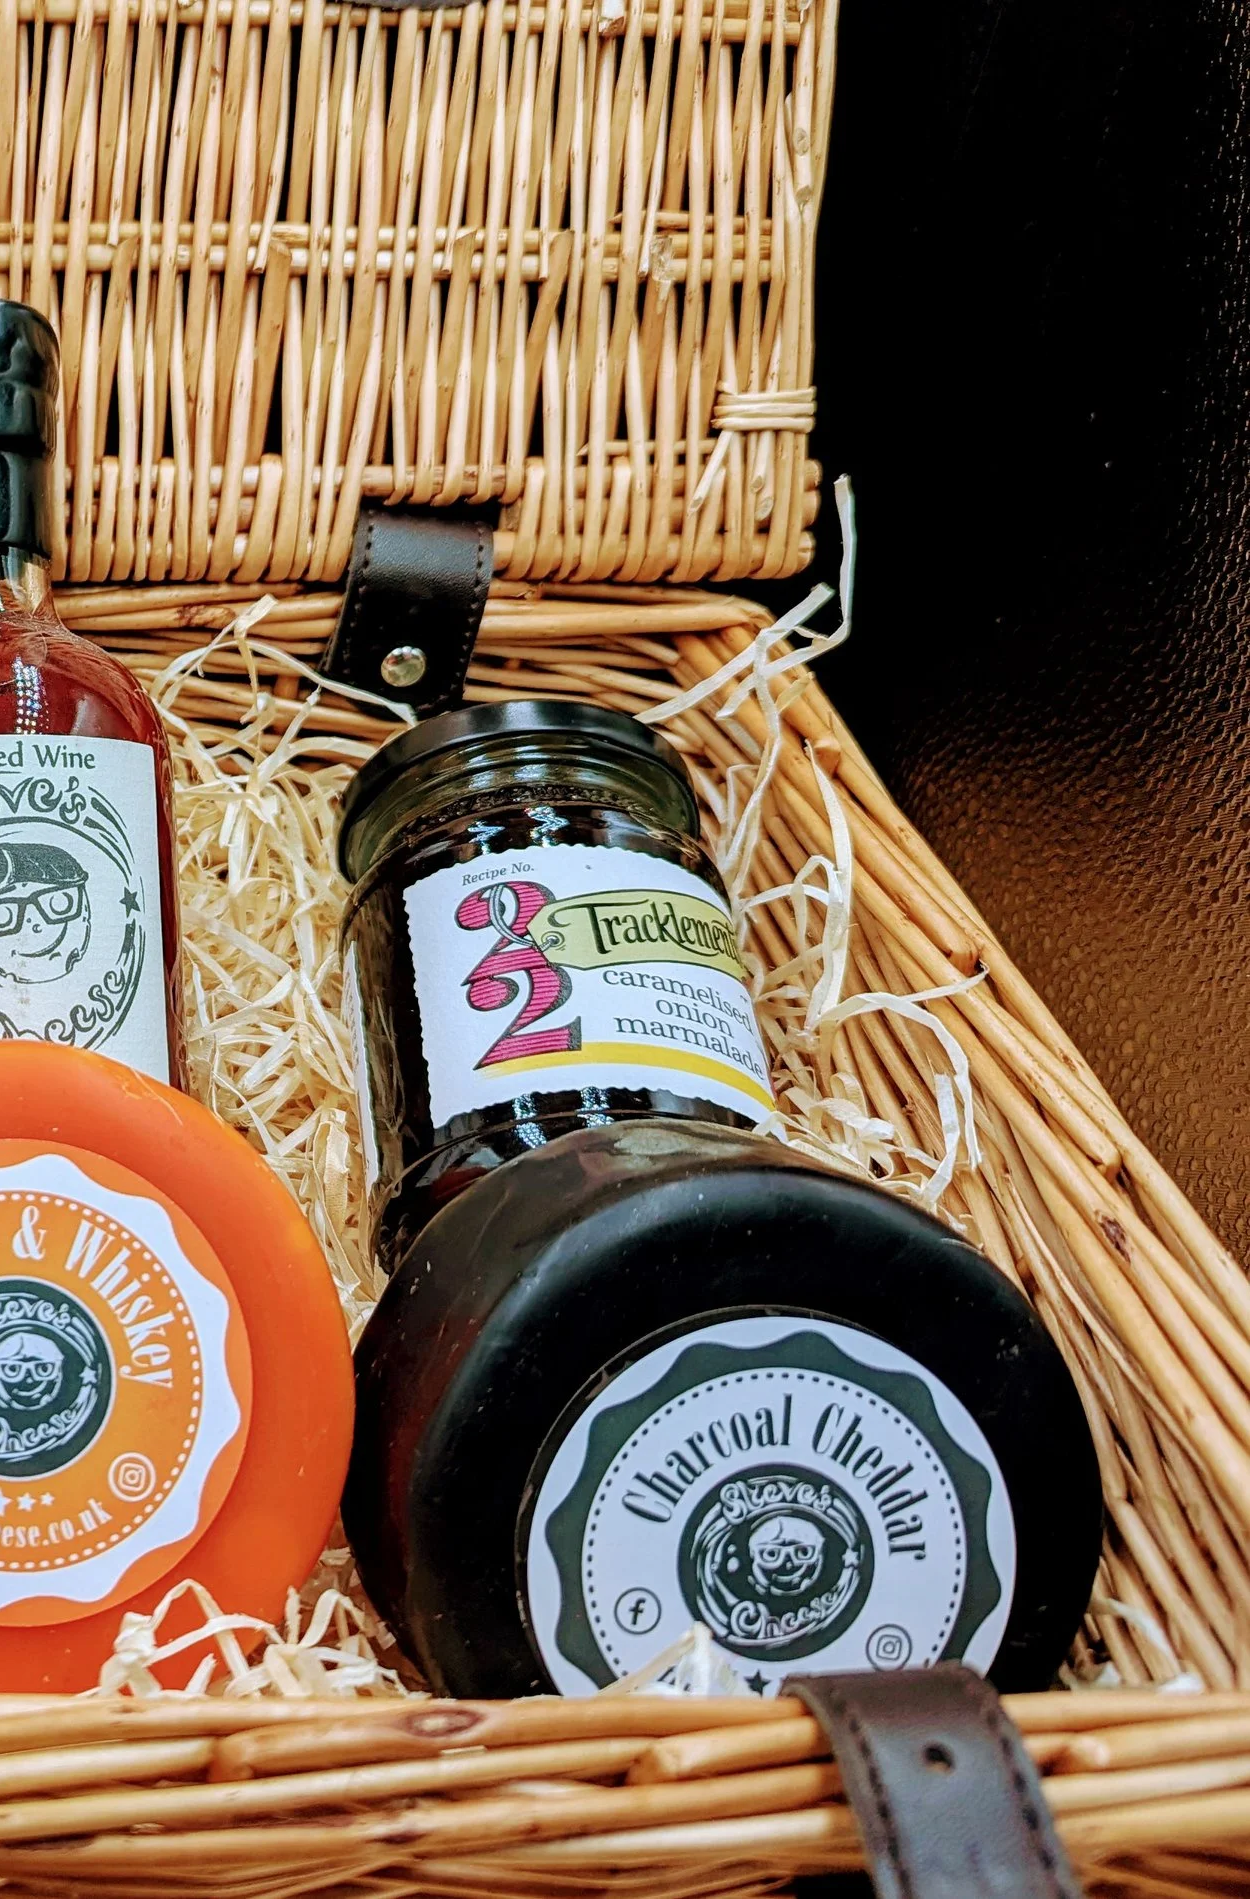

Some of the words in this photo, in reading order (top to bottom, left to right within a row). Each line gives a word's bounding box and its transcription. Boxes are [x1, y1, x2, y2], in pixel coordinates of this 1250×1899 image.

[33, 744, 97, 770] Wine
[461, 868, 507, 887] Recipe
[510, 861, 535, 875] No.
[602, 968, 755, 1036] caramelised
[655, 999, 735, 1039] onion
[614, 1015, 765, 1081] marmalade
[11, 1205, 47, 1260] &
[65, 1218, 176, 1389] Whiskey
[621, 1393, 794, 1523] Charcoal
[810, 1402, 928, 1562] Cheddar
